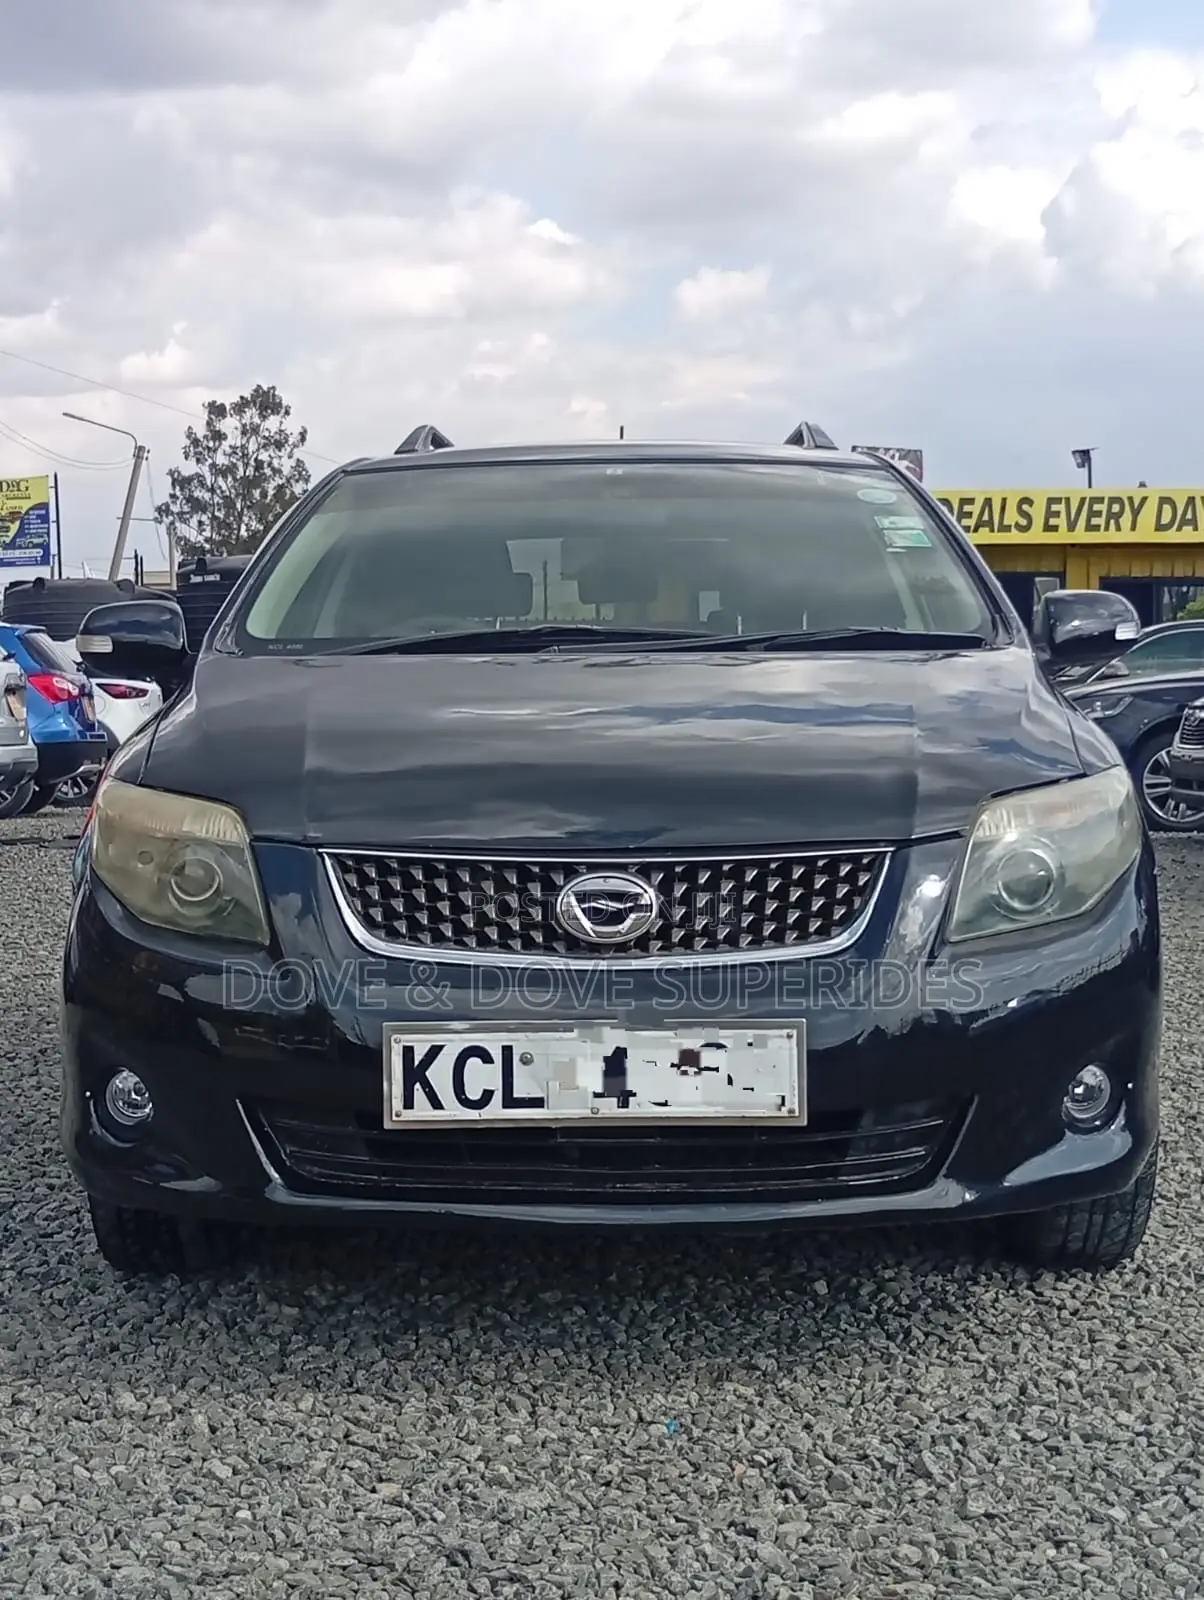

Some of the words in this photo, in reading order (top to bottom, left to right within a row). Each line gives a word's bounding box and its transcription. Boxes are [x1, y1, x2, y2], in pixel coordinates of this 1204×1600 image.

[1042, 496, 1149, 533] EVERY
[1154, 496, 1204, 533] DA
[402, 1044, 545, 1111] KCL
